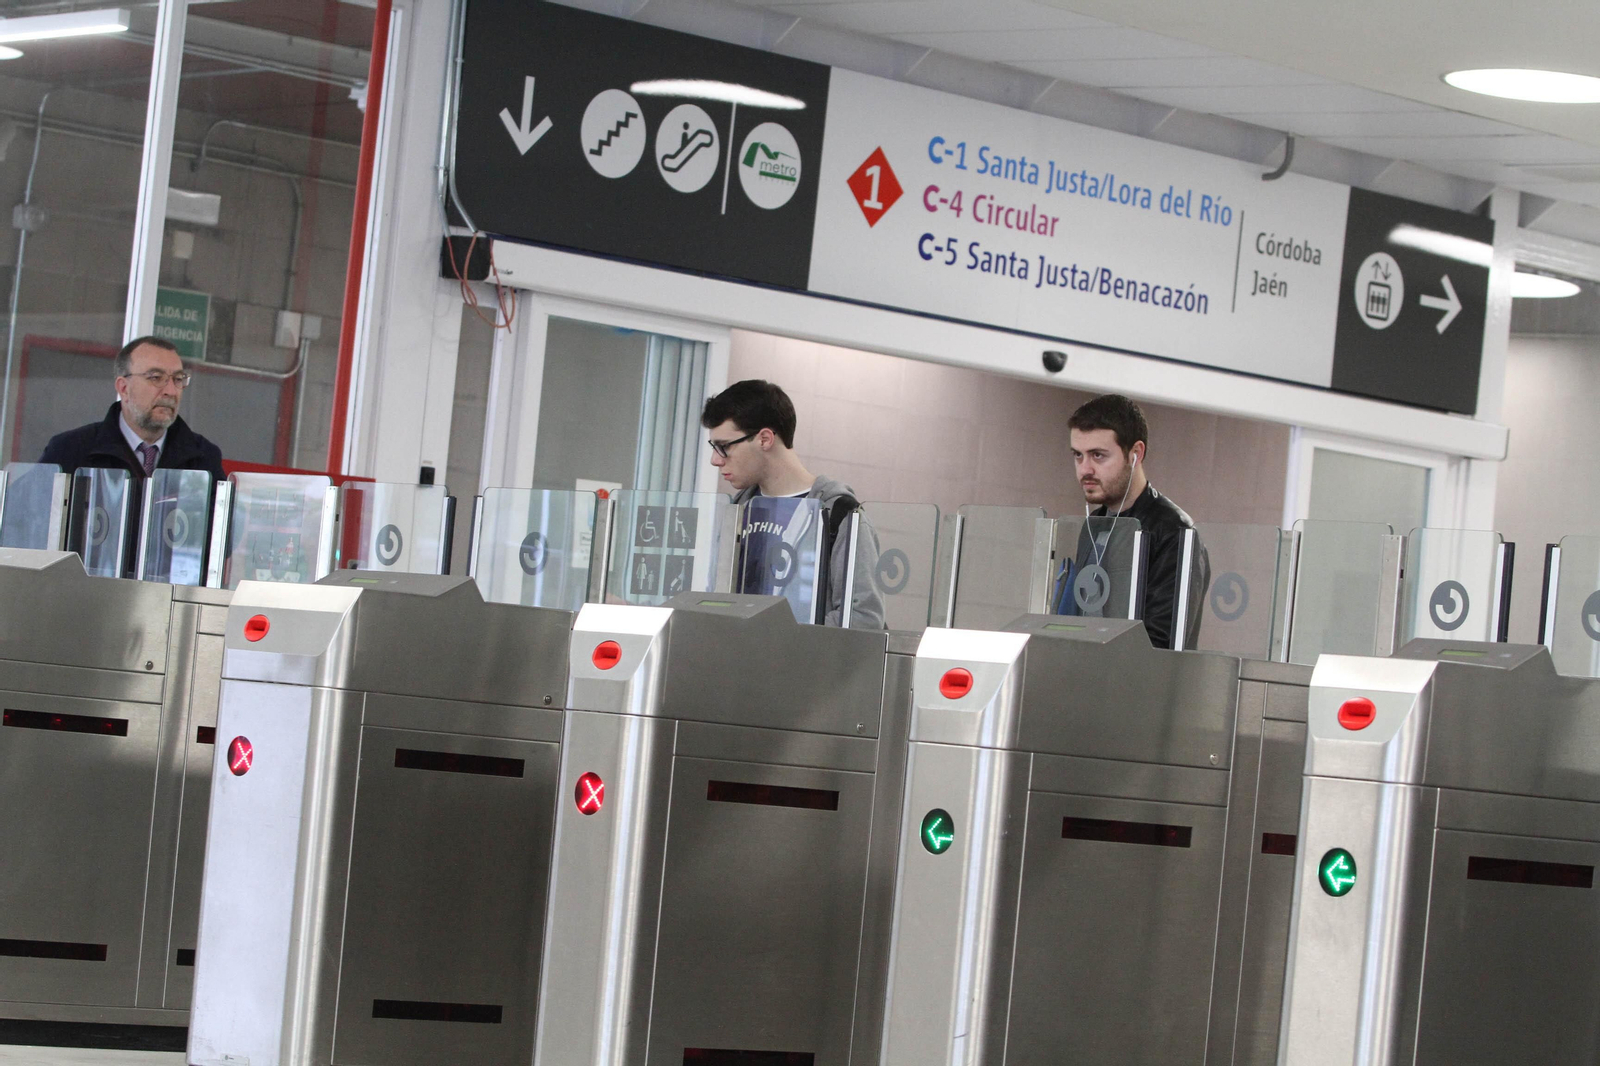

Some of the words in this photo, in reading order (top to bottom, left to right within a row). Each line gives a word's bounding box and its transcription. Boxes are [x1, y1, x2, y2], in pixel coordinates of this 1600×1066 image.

[759, 161, 797, 177] metro
[863, 164, 883, 210] 1
[927, 135, 968, 171] C-1
[976, 145, 1040, 186] Santa
[1045, 160, 1152, 210] Justa/Lora
[1159, 184, 1193, 219] del
[1199, 193, 1233, 227] Río
[922, 184, 964, 218] C-4
[972, 193, 1060, 238] Circular
[1255, 231, 1322, 266] Córdoba
[917, 232, 958, 266] C-5
[966, 241, 1030, 280] Santa
[1035, 255, 1209, 315] Justa/Benacazón
[1250, 269, 1288, 298] Jaén
[155, 305, 181, 320] LIDA
[183, 308, 199, 322] DE
